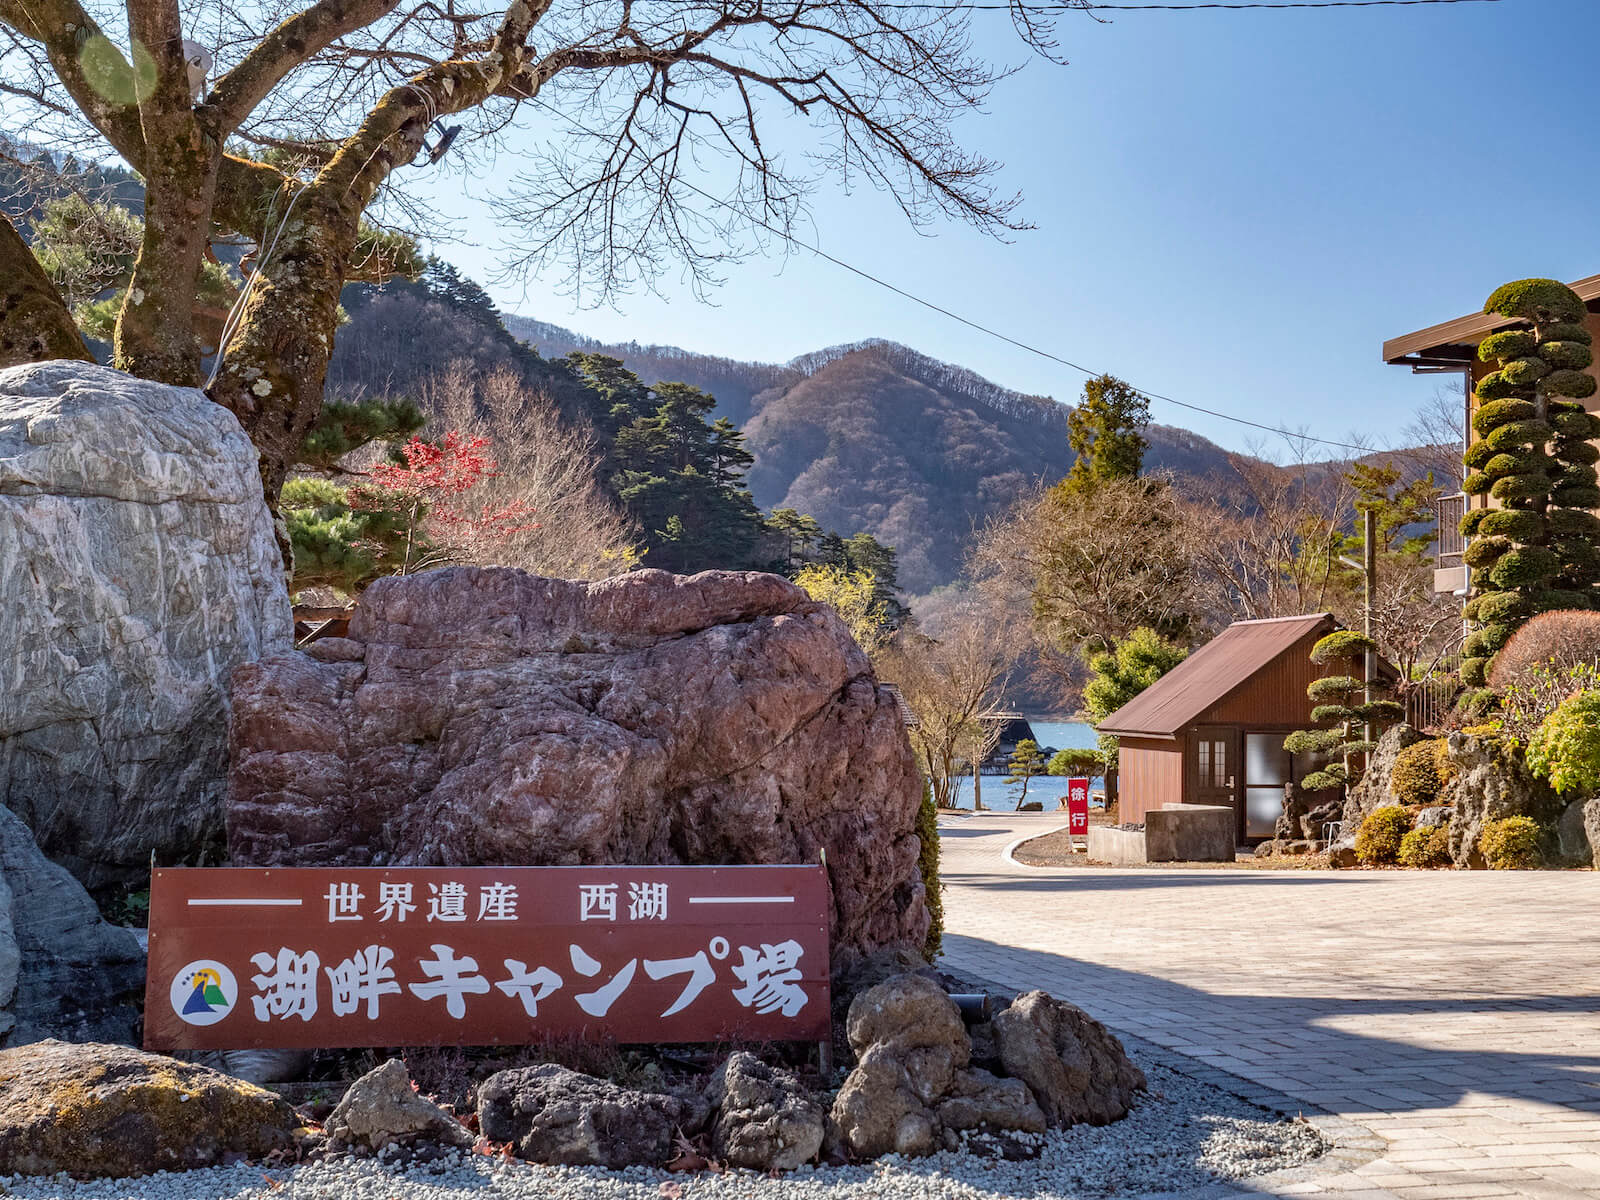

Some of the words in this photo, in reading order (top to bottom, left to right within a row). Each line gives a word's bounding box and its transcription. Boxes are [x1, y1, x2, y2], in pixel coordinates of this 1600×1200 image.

[1071, 787, 1086, 827] 徐行
[323, 882, 520, 923] 世界遺産
[578, 881, 669, 922] 西湖
[249, 937, 809, 1022] 湖畔キャンプ場
